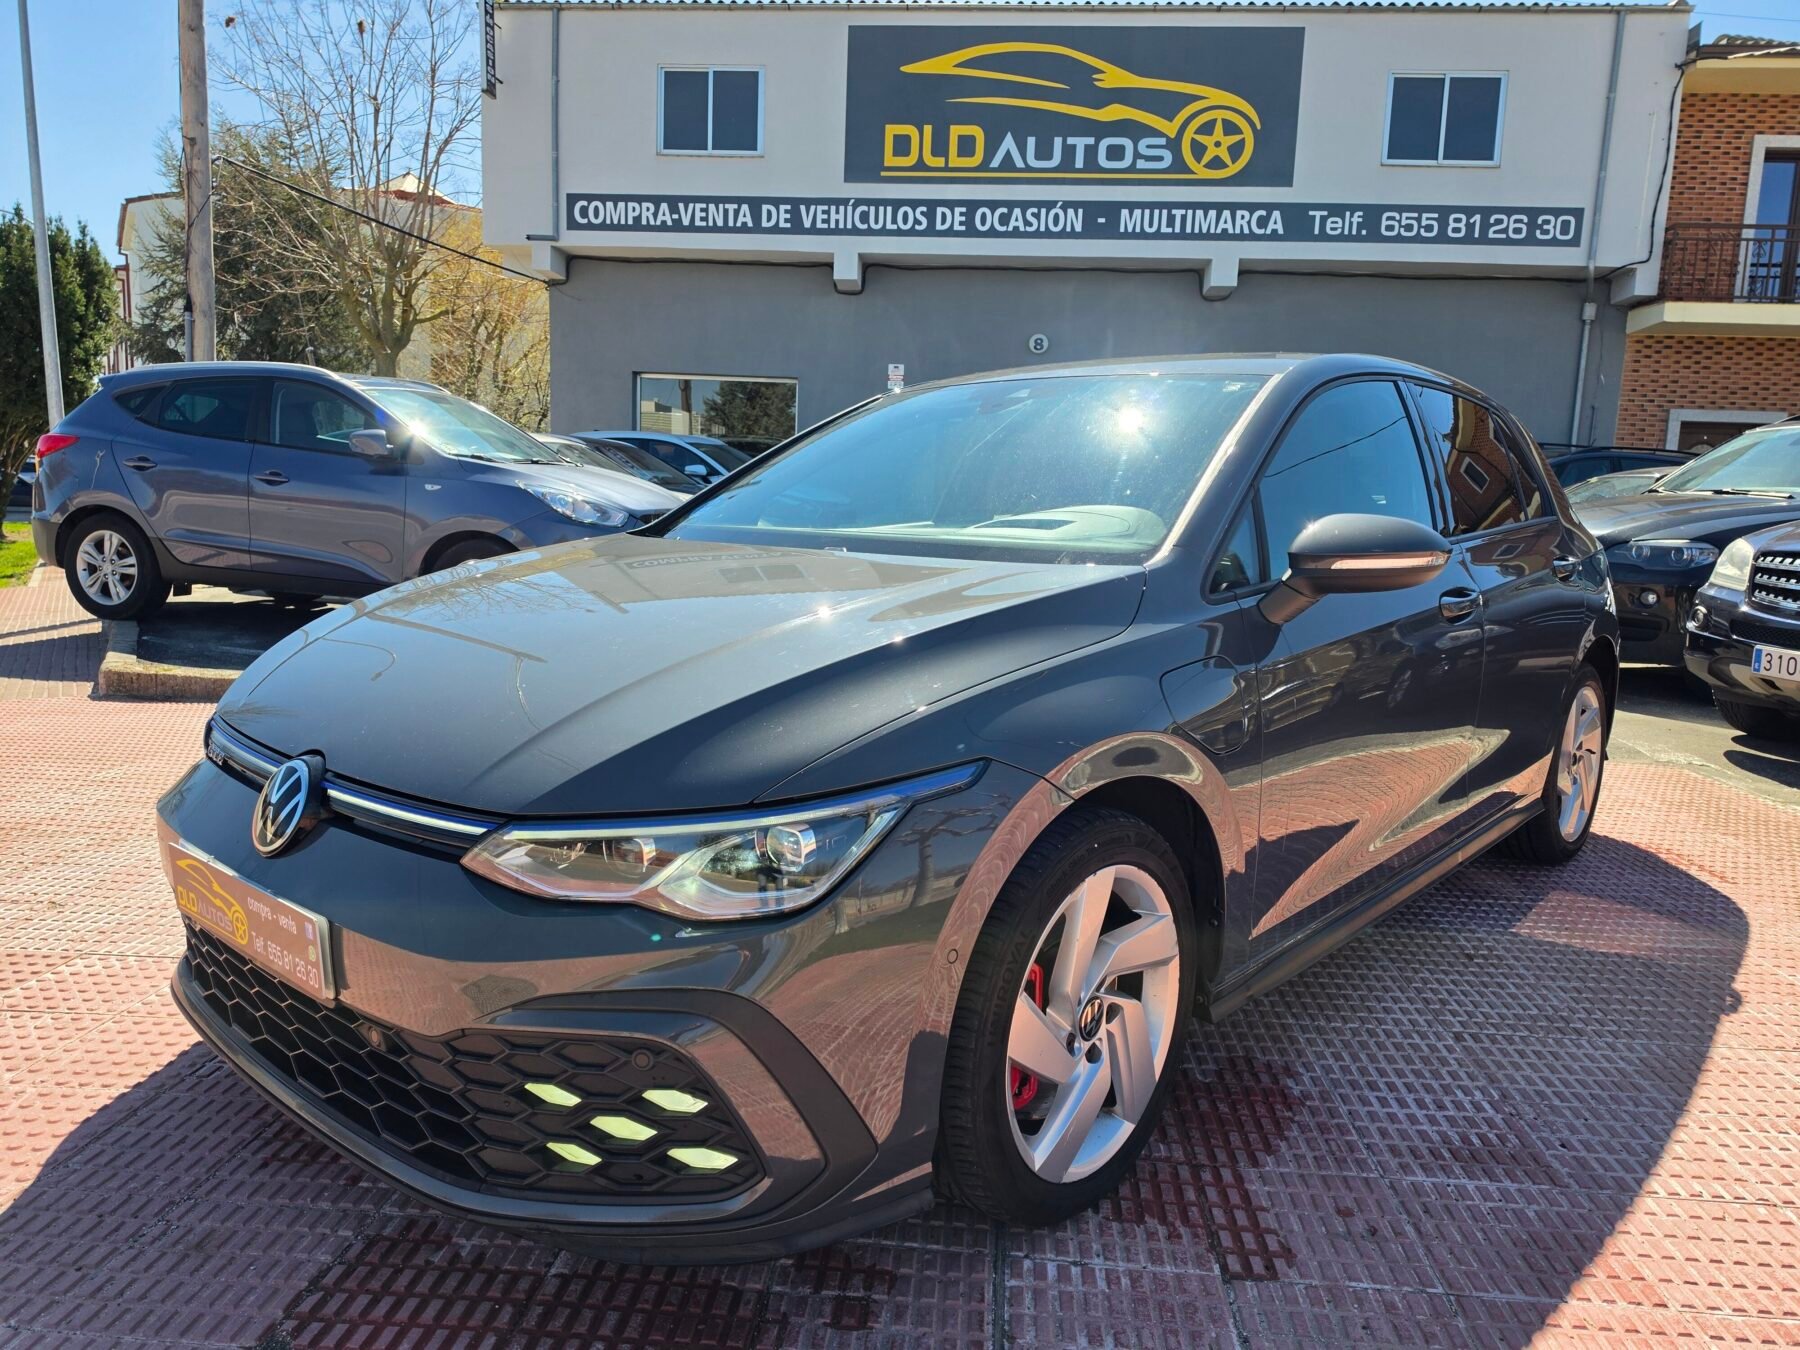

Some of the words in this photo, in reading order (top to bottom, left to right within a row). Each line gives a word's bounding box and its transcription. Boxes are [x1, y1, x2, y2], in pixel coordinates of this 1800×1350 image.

[884, 124, 985, 168] DLD
[989, 131, 1174, 169] AUTOS
[573, 200, 754, 228] COMPRA-VENTA
[761, 204, 792, 229] DE
[800, 199, 928, 231] VEHÍCULOS
[936, 206, 967, 231] DE
[974, 202, 1084, 233] OCASIÓN
[1119, 208, 1284, 235] MULTIMARCA
[1308, 210, 1367, 236] Telf.
[1380, 211, 1439, 237] 655
[1535, 215, 1576, 240] 30
[1032, 337, 1045, 351] 8
[176, 885, 198, 913] DLD
[247, 896, 272, 923] compra
[278, 912, 297, 935] venta
[267, 940, 283, 966] 655
[283, 953, 294, 973] 81
[295, 958, 307, 982] 26
[307, 967, 319, 989] 30
